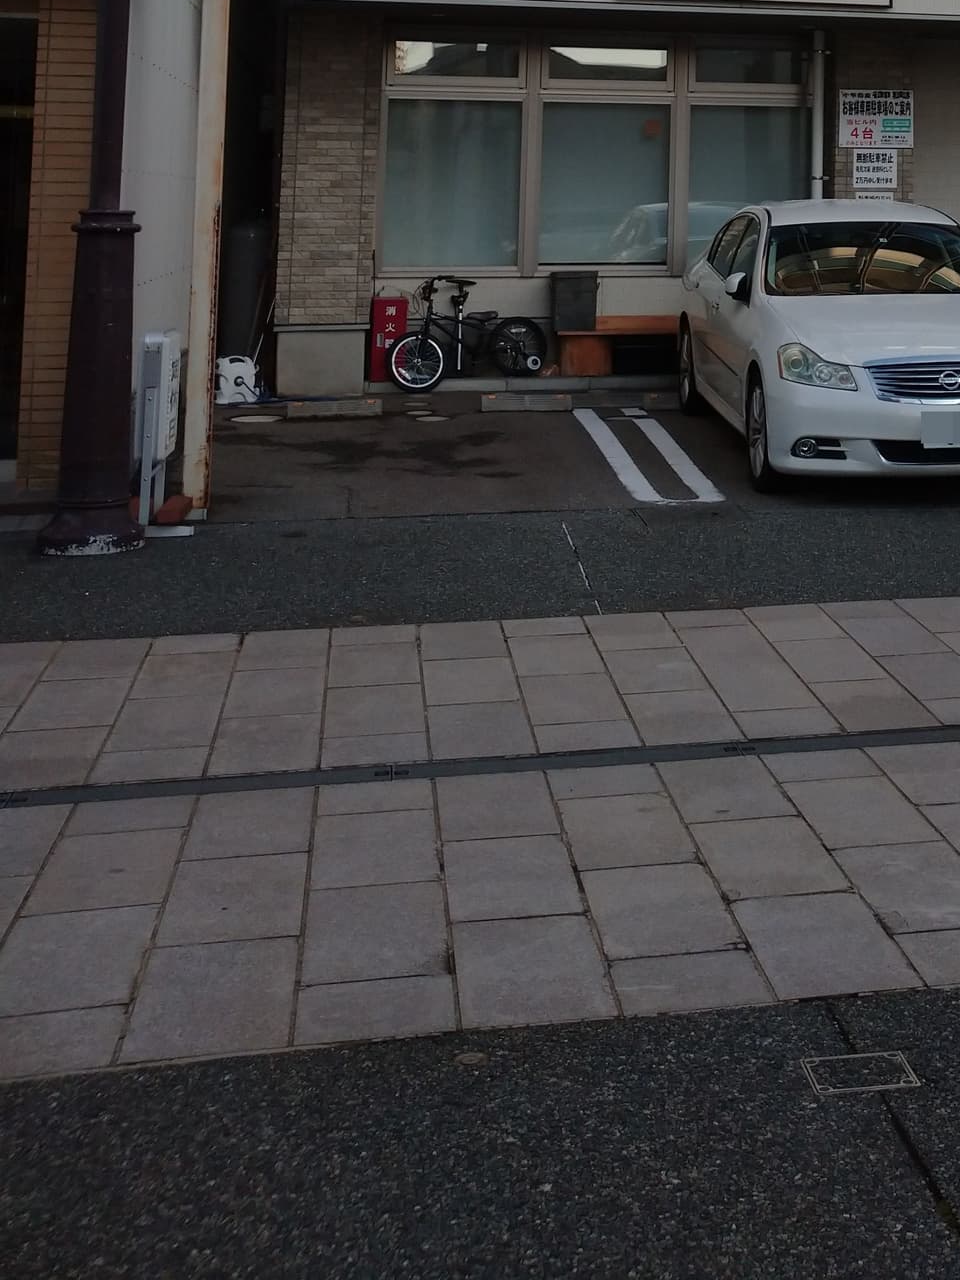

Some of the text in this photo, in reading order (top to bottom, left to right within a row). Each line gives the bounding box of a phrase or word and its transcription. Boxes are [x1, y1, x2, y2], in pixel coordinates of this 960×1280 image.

[856, 152, 894, 164] 無断駐車禁止
